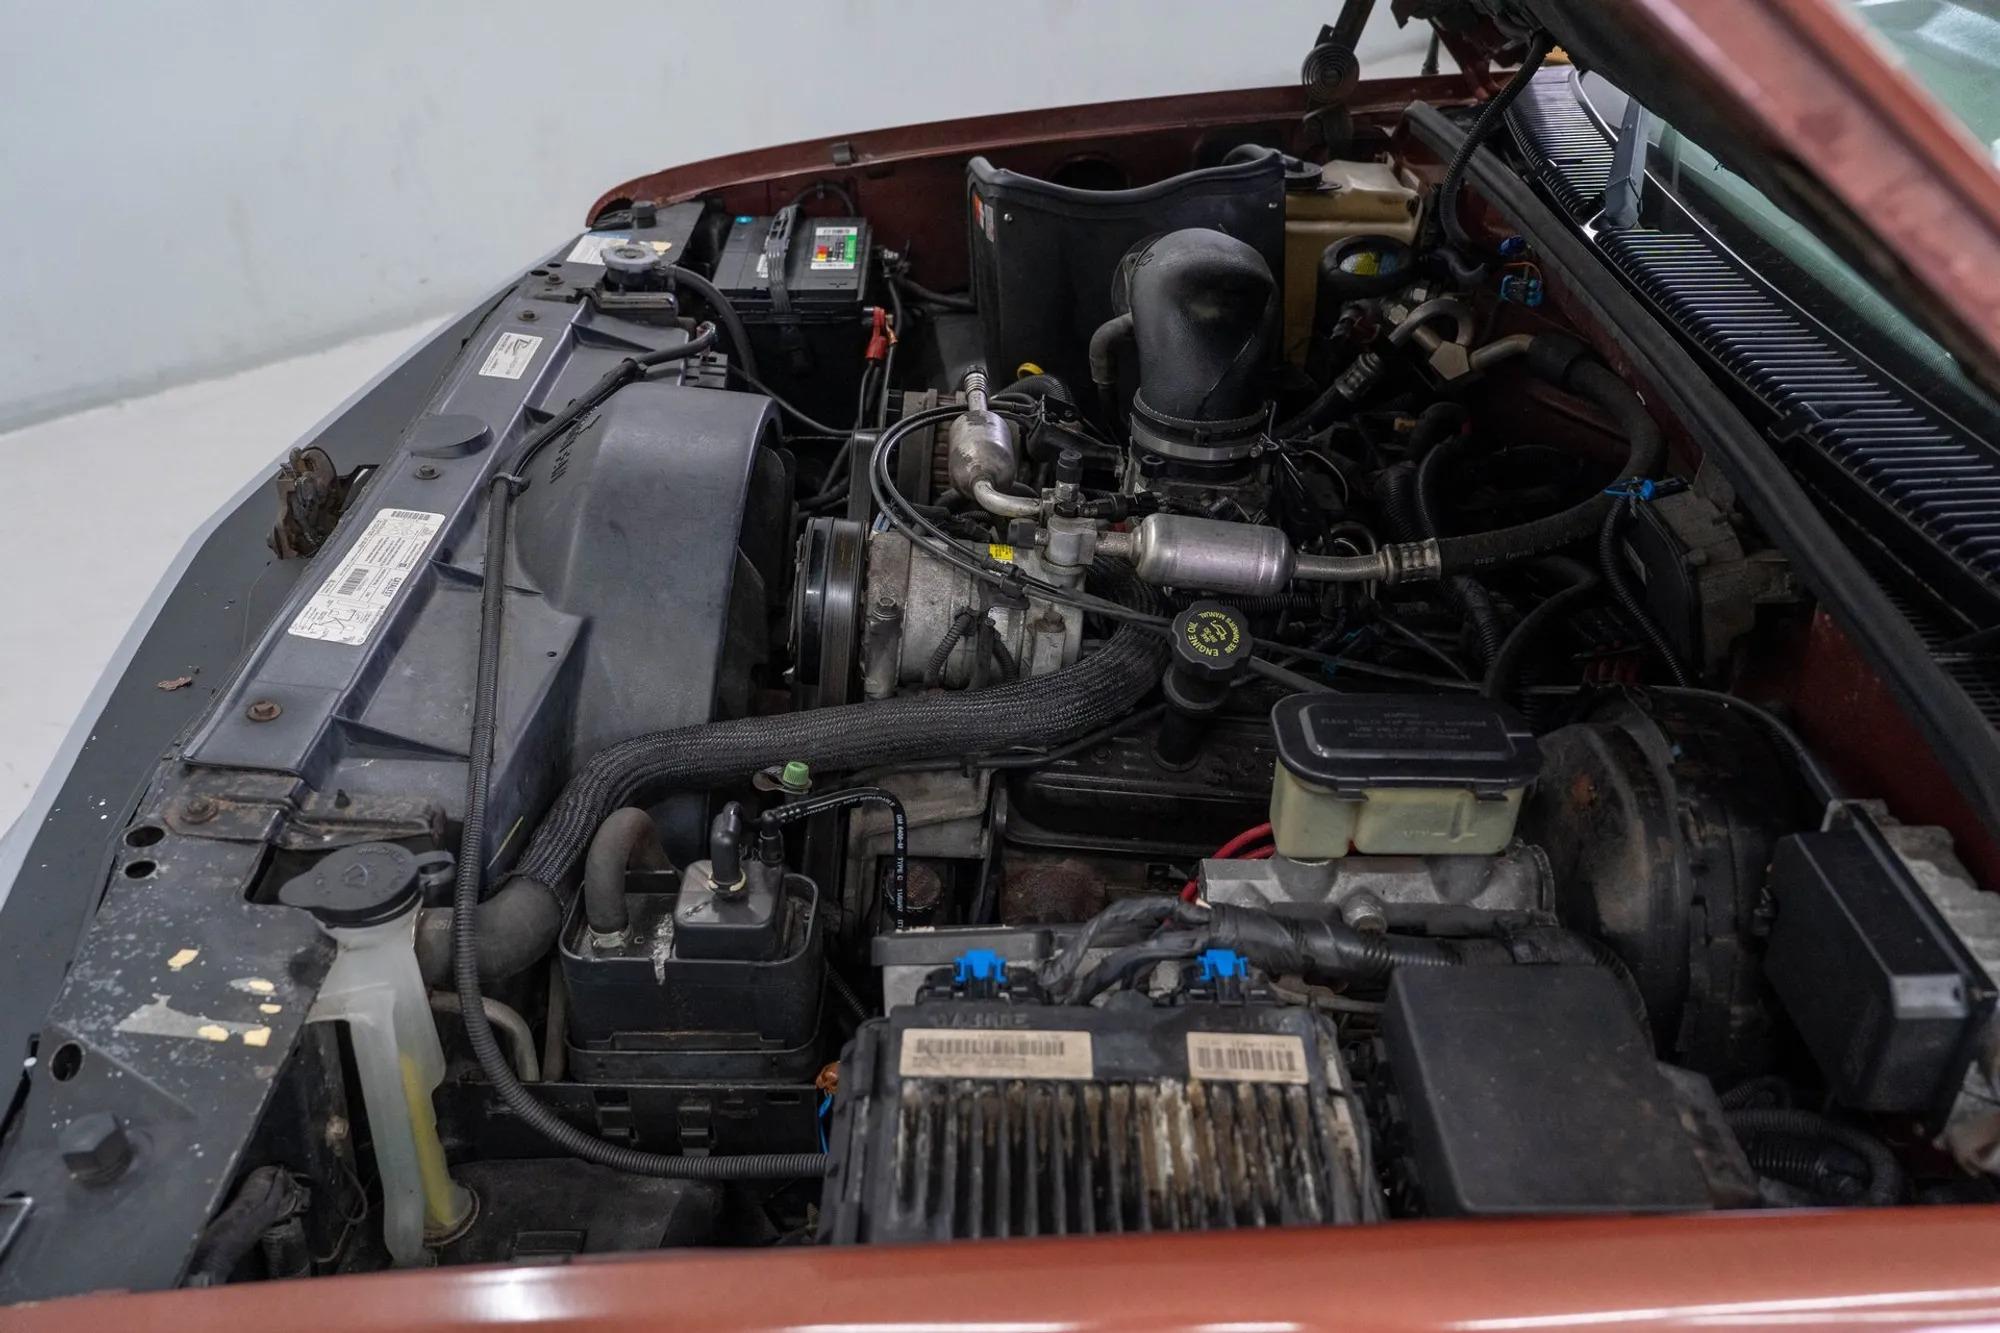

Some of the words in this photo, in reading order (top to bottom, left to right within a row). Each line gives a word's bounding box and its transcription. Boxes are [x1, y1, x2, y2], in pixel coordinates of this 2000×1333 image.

[1197, 611, 1226, 620] MANUAL
[1187, 621, 1199, 633] OIL
[1188, 634, 1219, 657] ENGINE
